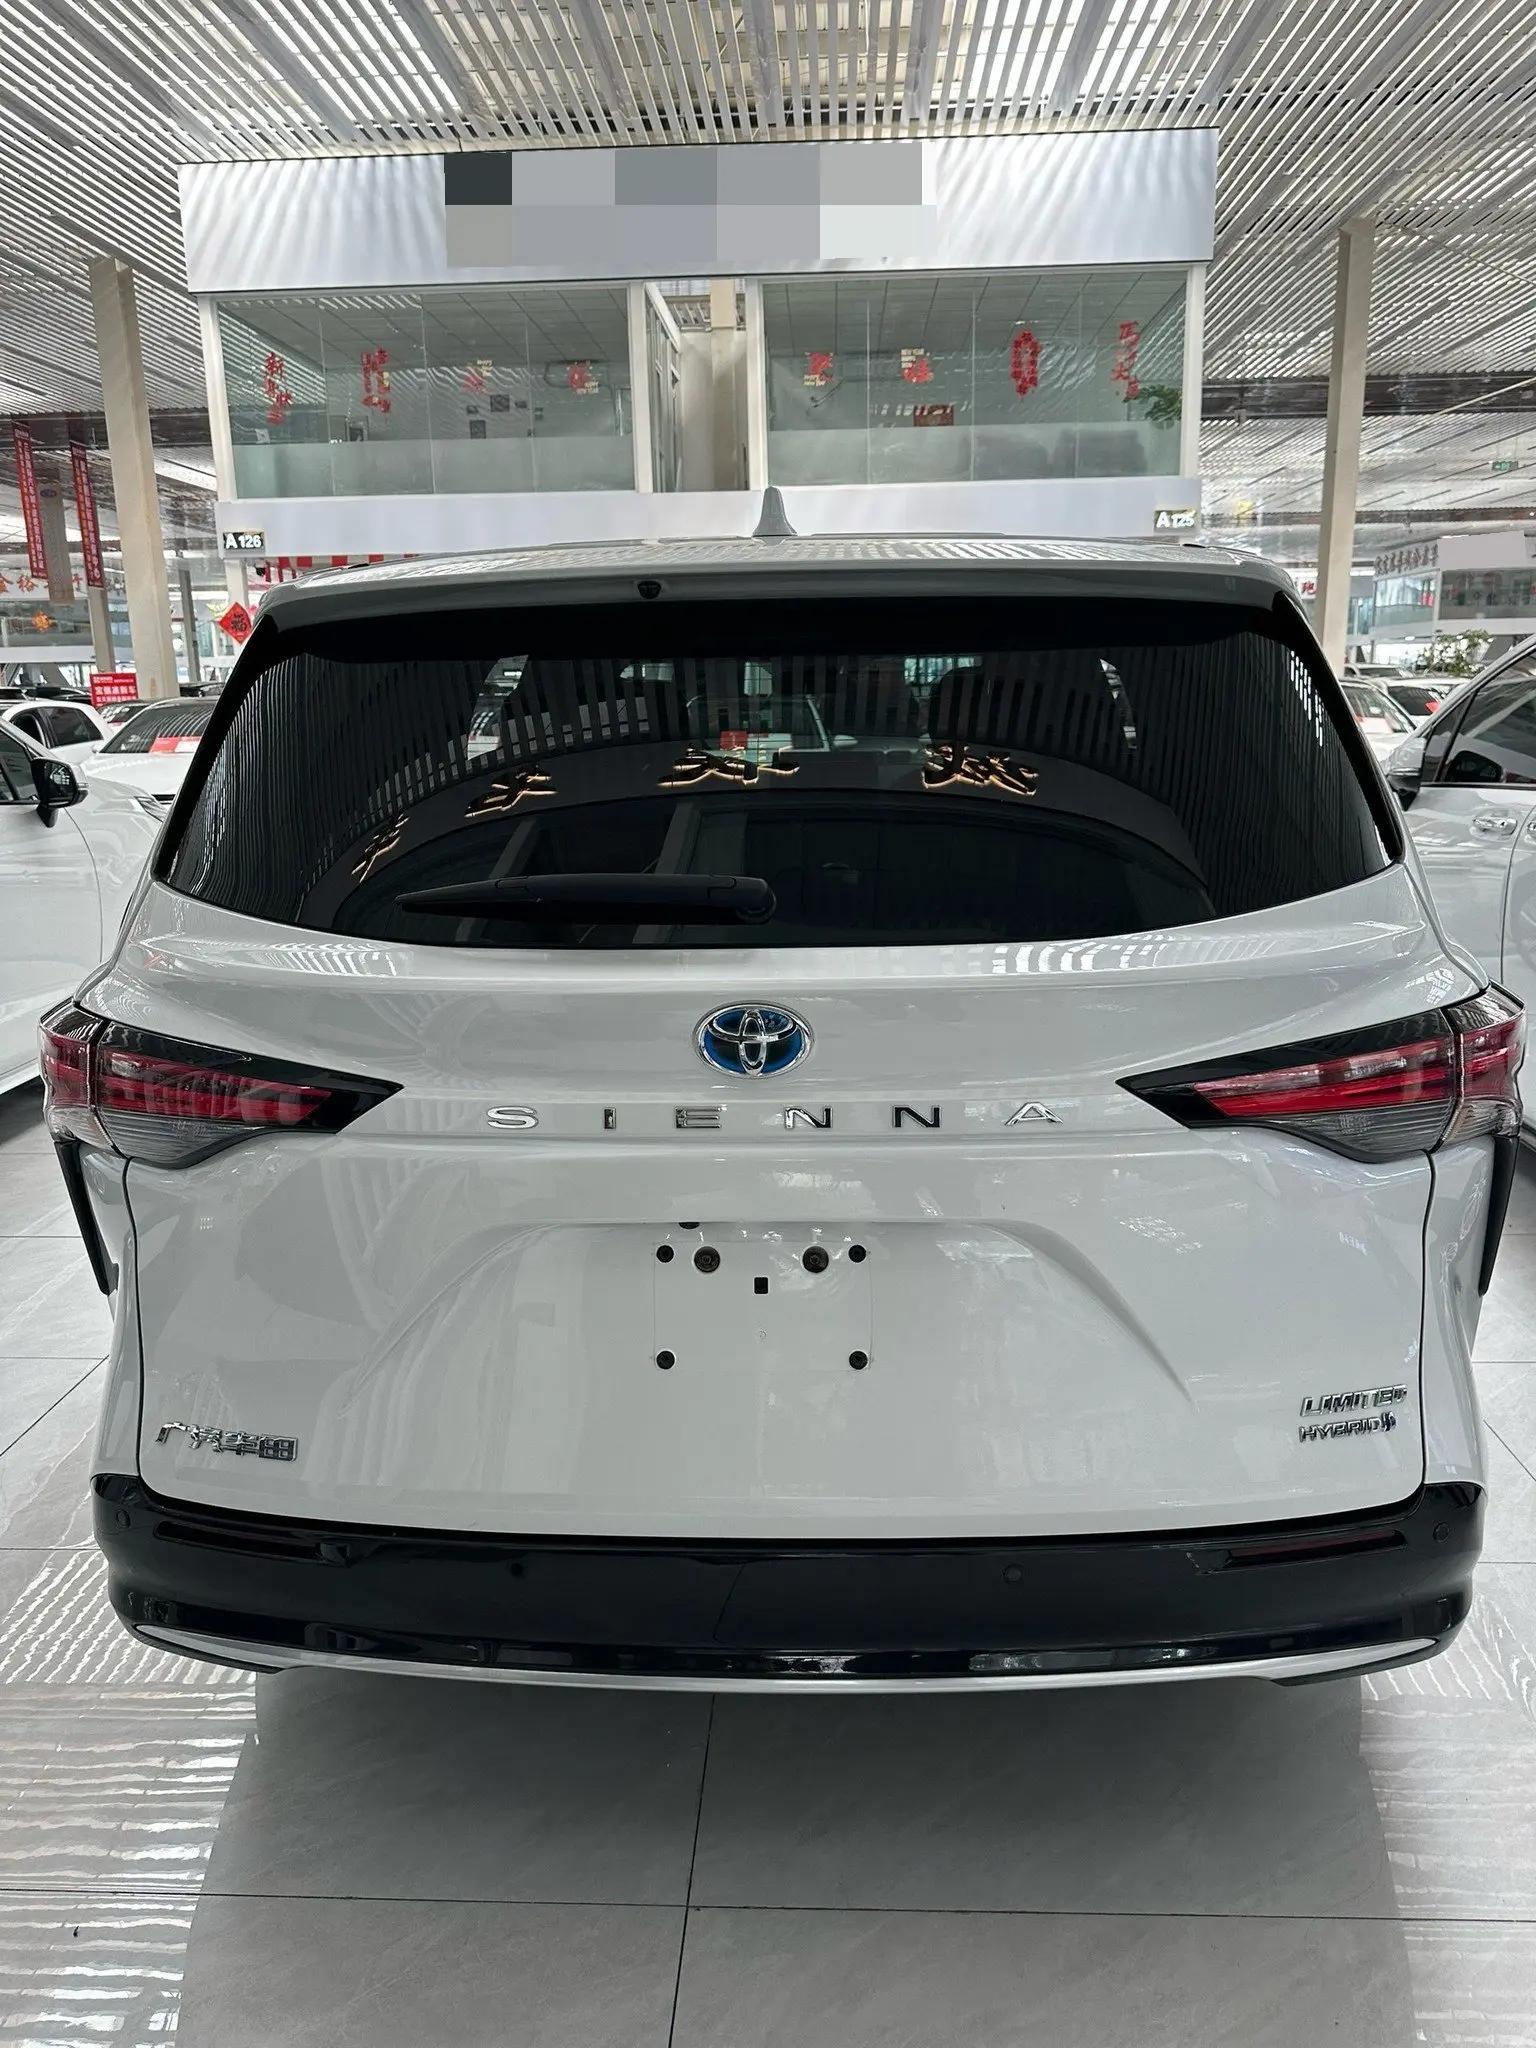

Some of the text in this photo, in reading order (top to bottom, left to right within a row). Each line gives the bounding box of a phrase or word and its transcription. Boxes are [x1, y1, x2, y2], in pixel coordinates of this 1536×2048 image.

[225, 533, 262, 549] A126
[486, 1101, 1064, 1130] SIENNA
[1300, 1384, 1407, 1416] LIMITED
[155, 1421, 298, 1461] 广汽丰田
[1299, 1417, 1381, 1442] HYBRID
